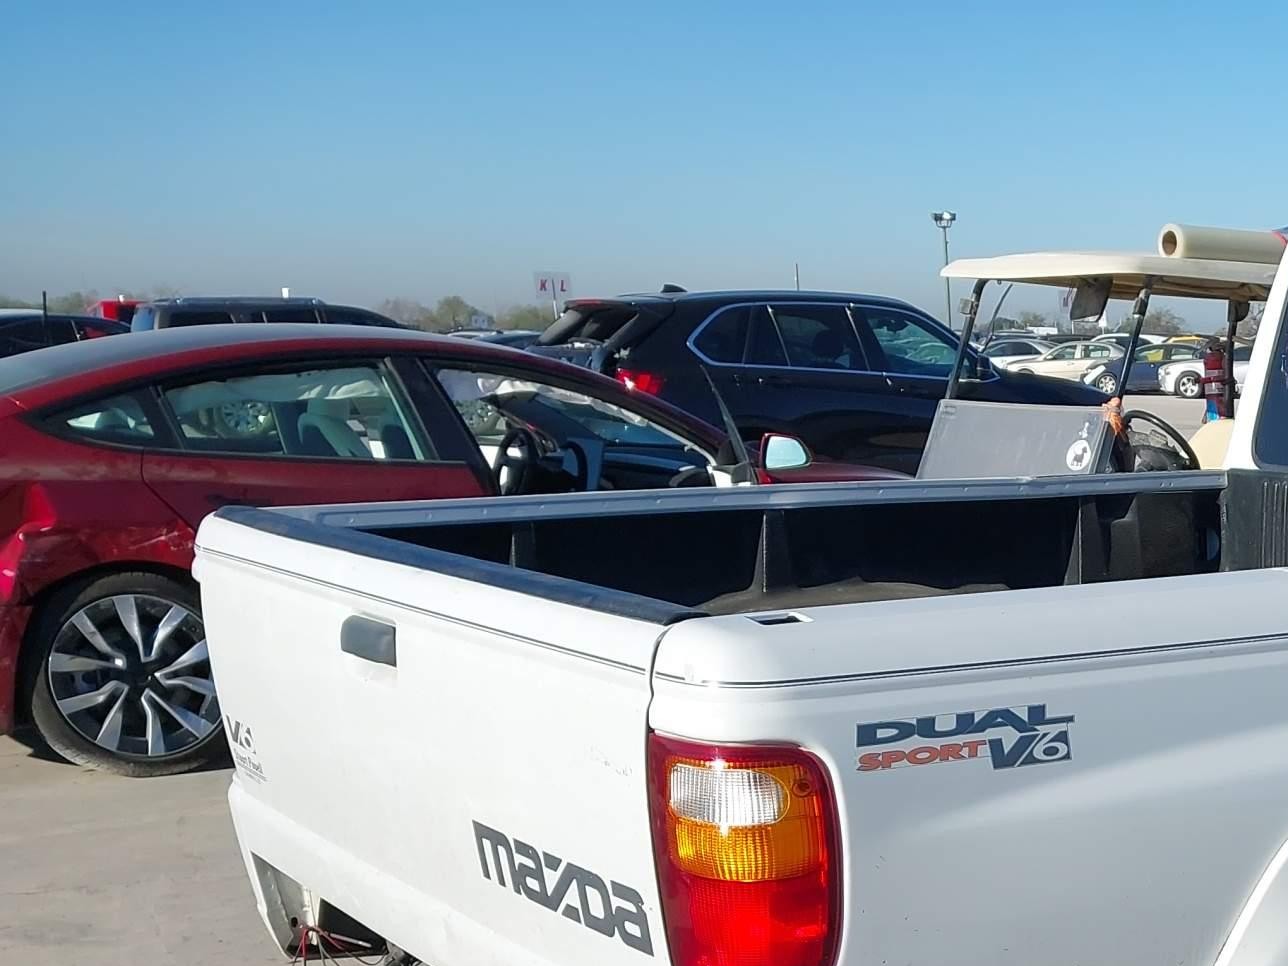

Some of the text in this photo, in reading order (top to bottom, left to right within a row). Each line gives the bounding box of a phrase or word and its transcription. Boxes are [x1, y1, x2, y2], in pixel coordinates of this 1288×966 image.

[560, 279, 567, 292] L
[856, 704, 1074, 747] DUAL
[856, 730, 1072, 771] SPORT V6
